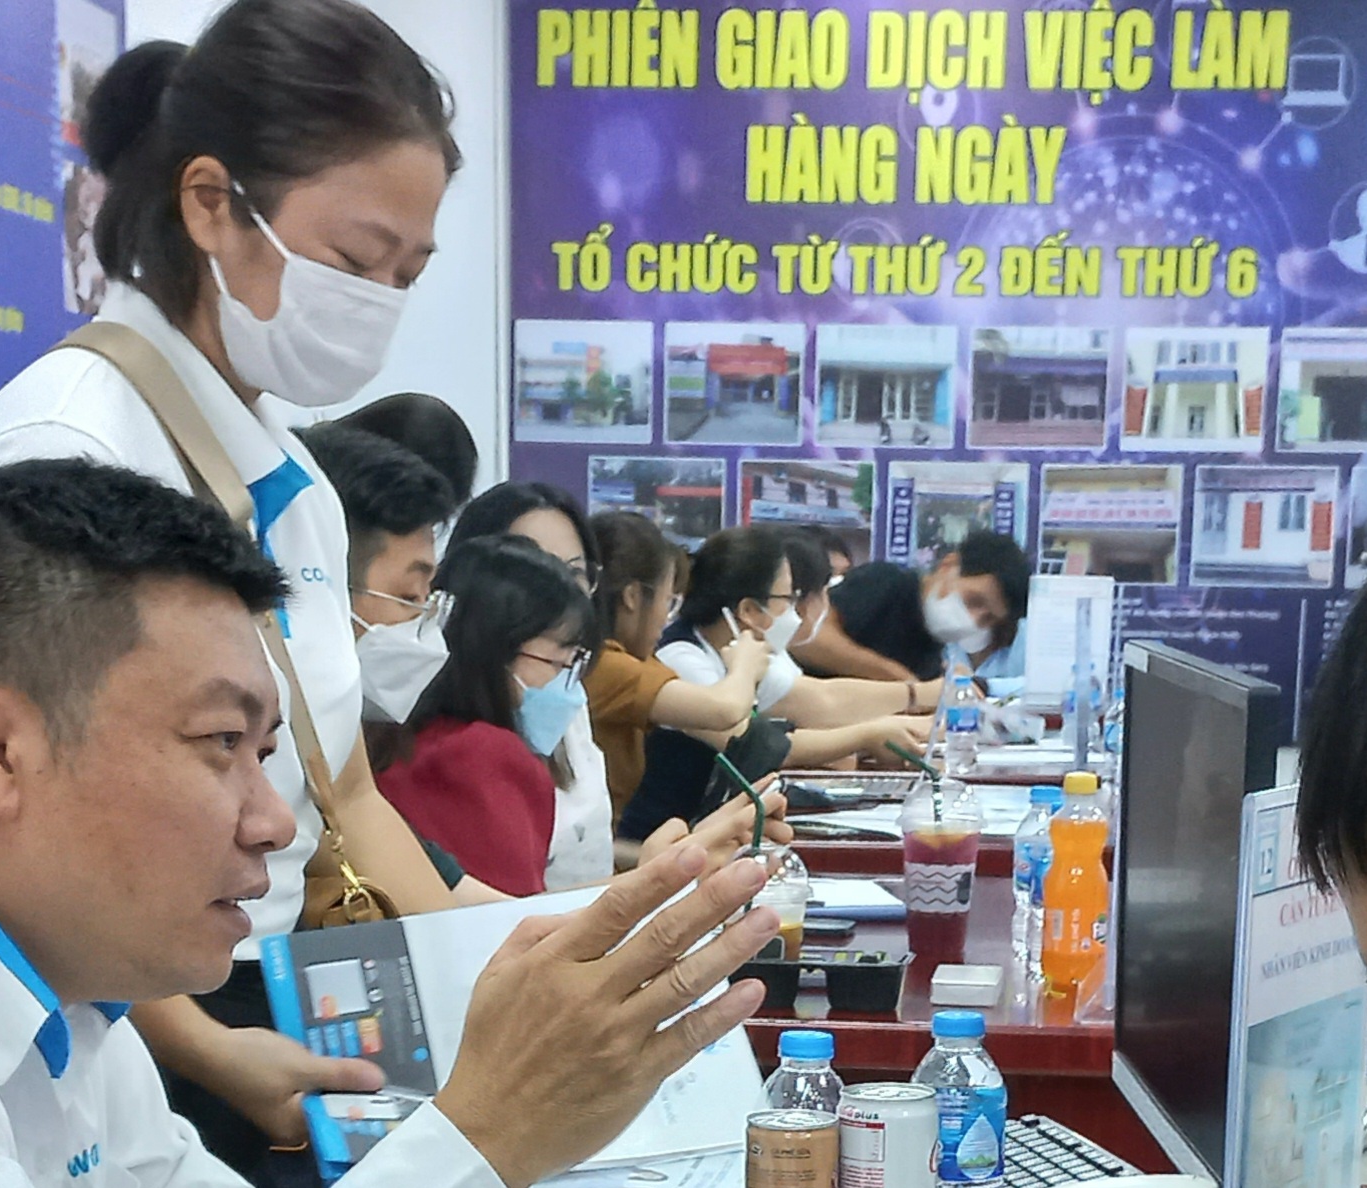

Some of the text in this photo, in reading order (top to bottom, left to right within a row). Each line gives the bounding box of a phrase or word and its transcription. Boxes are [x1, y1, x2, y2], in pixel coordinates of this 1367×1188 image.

[537, 0, 1290, 104] PHIÊN GIAO DỊCH VIỆC LÀM
[746, 113, 1066, 205] HÀNG NGÀY
[553, 223, 1257, 298] TỔ CHỨC TỪ THỨ 2 ĐẾN THỨ 6
